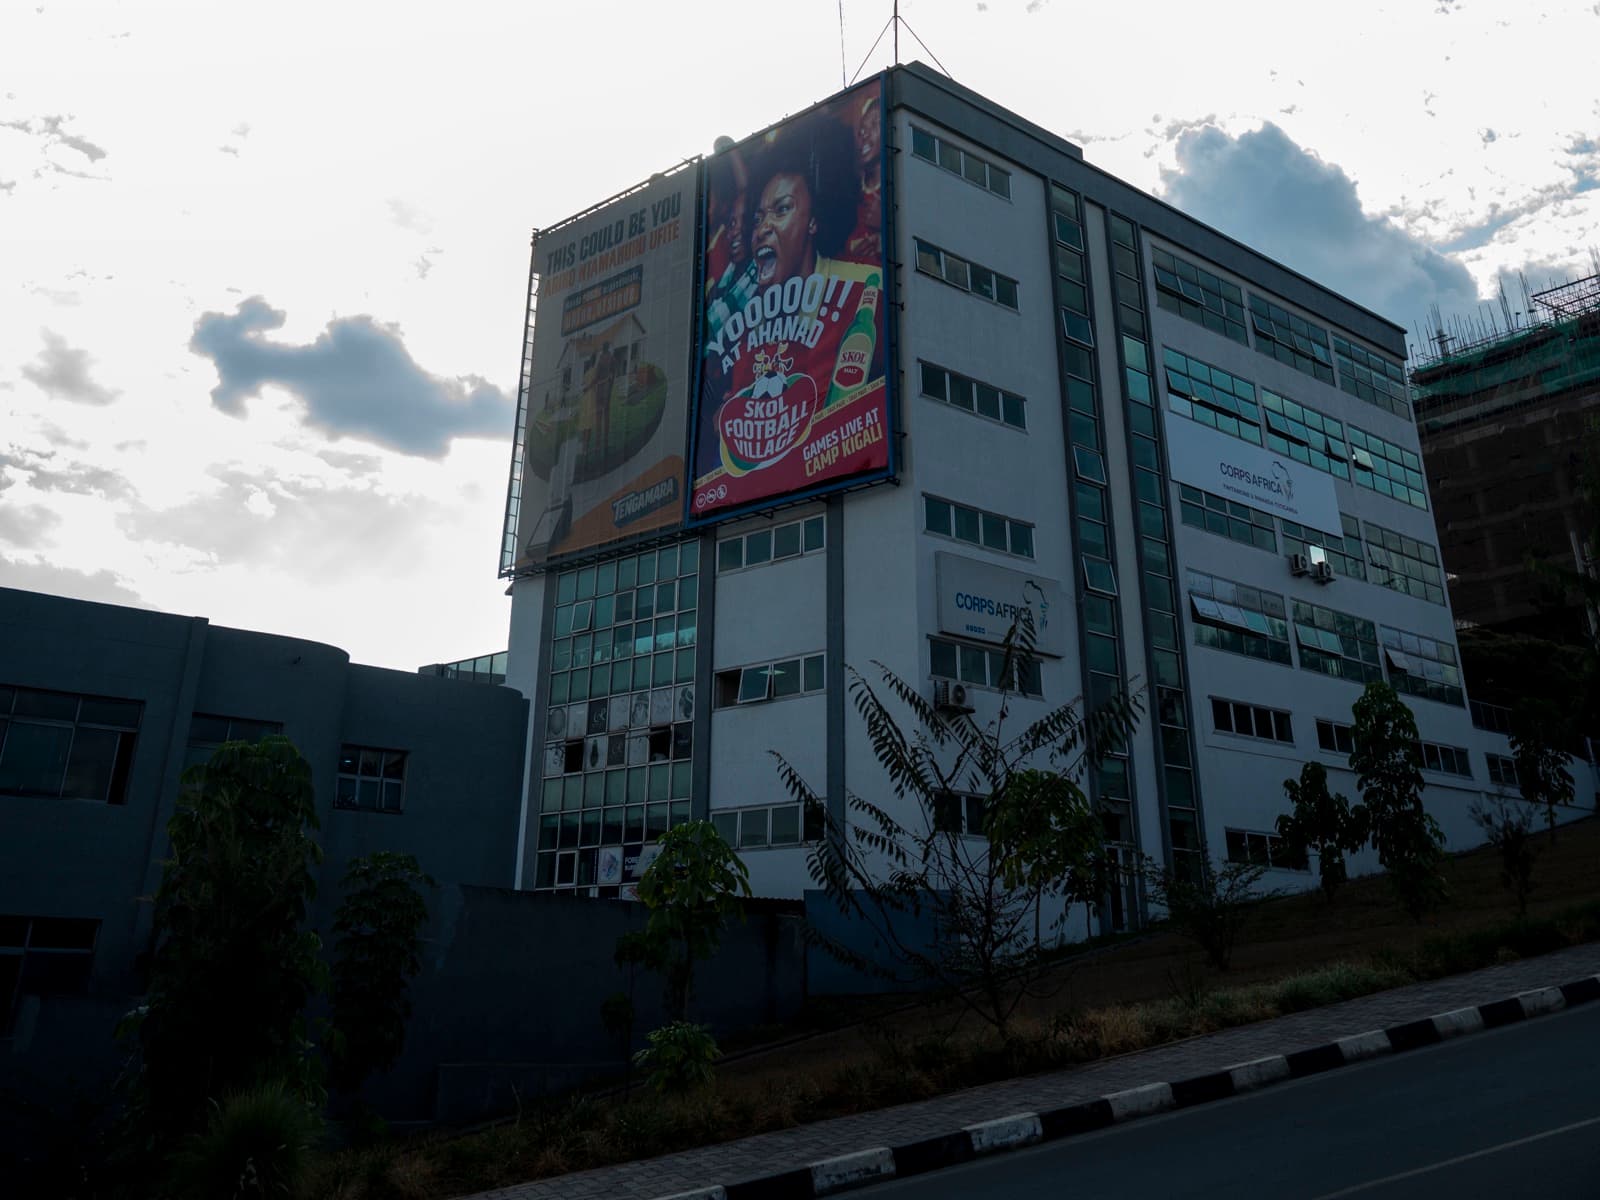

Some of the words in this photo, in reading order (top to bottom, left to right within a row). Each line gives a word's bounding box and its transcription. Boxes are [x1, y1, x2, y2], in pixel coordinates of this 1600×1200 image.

[547, 242, 576, 275] THIS
[580, 218, 624, 261] COULD
[628, 208, 647, 239] BE
[652, 191, 682, 227] YOU
[721, 341, 742, 375] AT
[841, 351, 866, 365] SKOL
[725, 400, 808, 440] FOOTBALL
[744, 396, 789, 419] SKOL
[734, 422, 800, 459] VILLAGE
[803, 429, 840, 461] GAMES
[840, 414, 865, 440] LIVE
[865, 407, 879, 427] AT
[805, 445, 840, 478] CAMP
[842, 422, 883, 458] KIGALI
[612, 477, 674, 521] TENGAMARA
